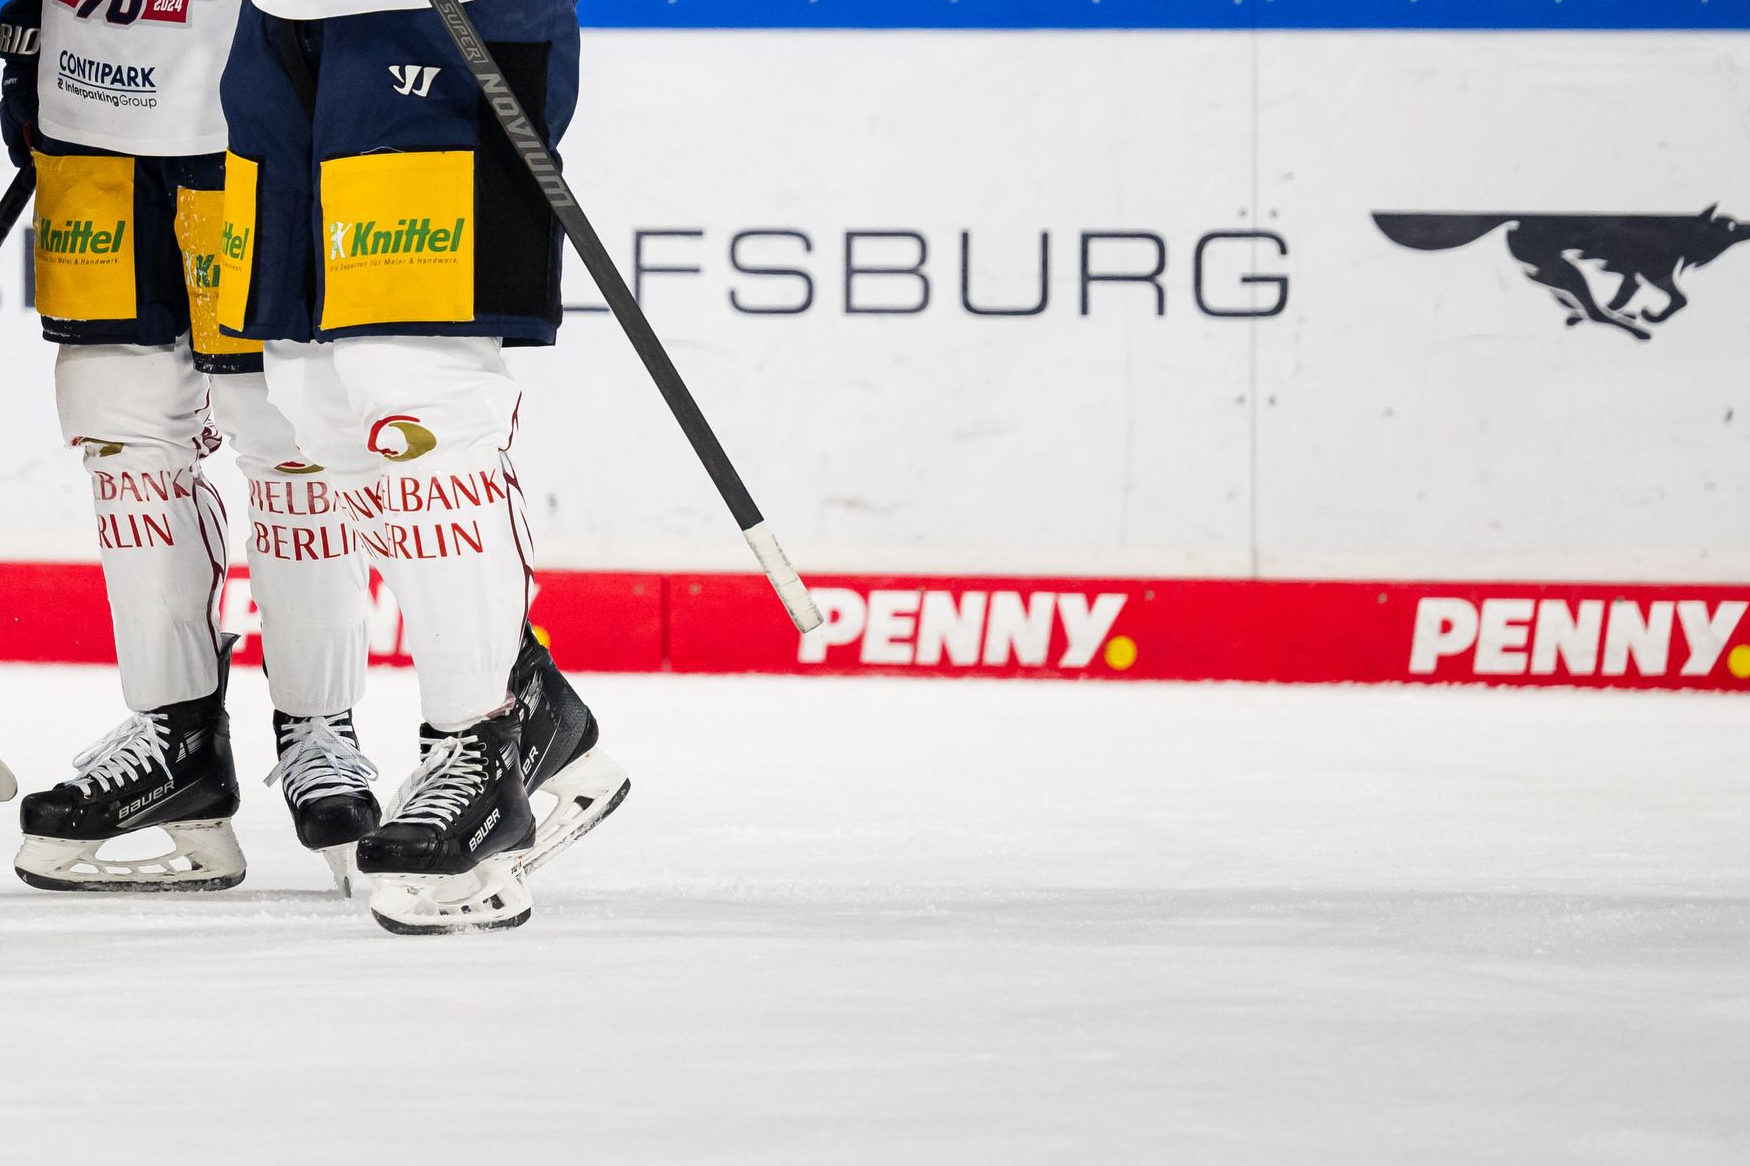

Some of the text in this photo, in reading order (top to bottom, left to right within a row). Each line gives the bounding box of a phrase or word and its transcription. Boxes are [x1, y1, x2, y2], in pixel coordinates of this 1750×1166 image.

[59, 50, 156, 88] CONTIPARK
[439, 2, 577, 207] SUPER NOVIUM
[40, 220, 127, 255] Knittel
[350, 217, 466, 258] Knittel
[468, 807, 502, 853] BAUER
